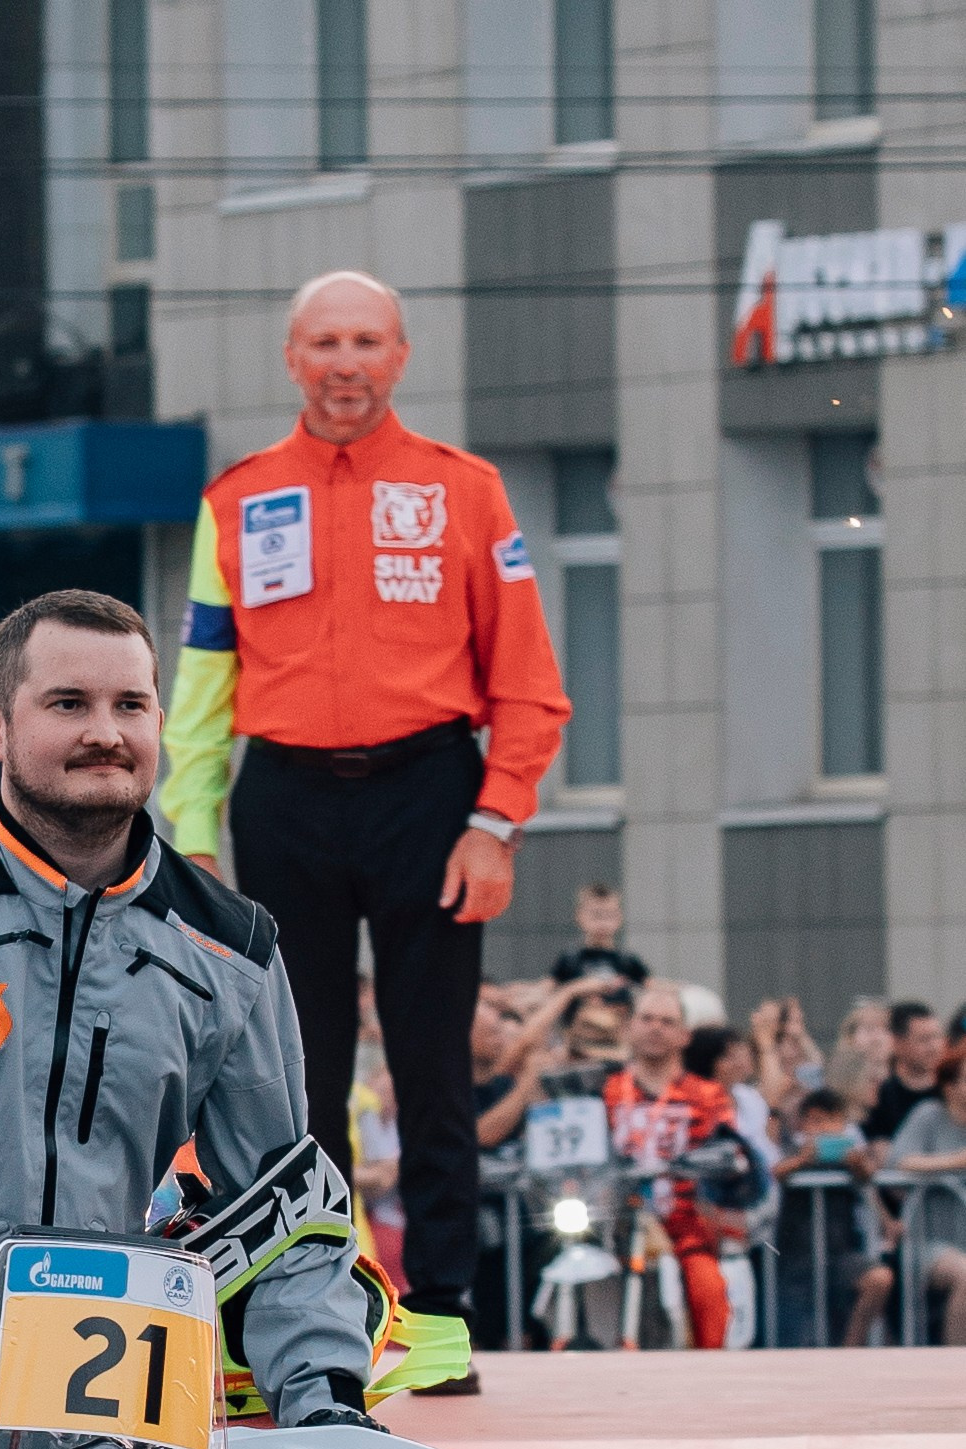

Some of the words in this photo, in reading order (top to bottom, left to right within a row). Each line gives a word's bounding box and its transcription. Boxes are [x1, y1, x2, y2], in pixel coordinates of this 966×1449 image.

[374, 554, 442, 579] SILK
[376, 579, 442, 604] WAY
[50, 1273, 104, 1291] GAZPROM
[65, 1316, 167, 1425] 21
